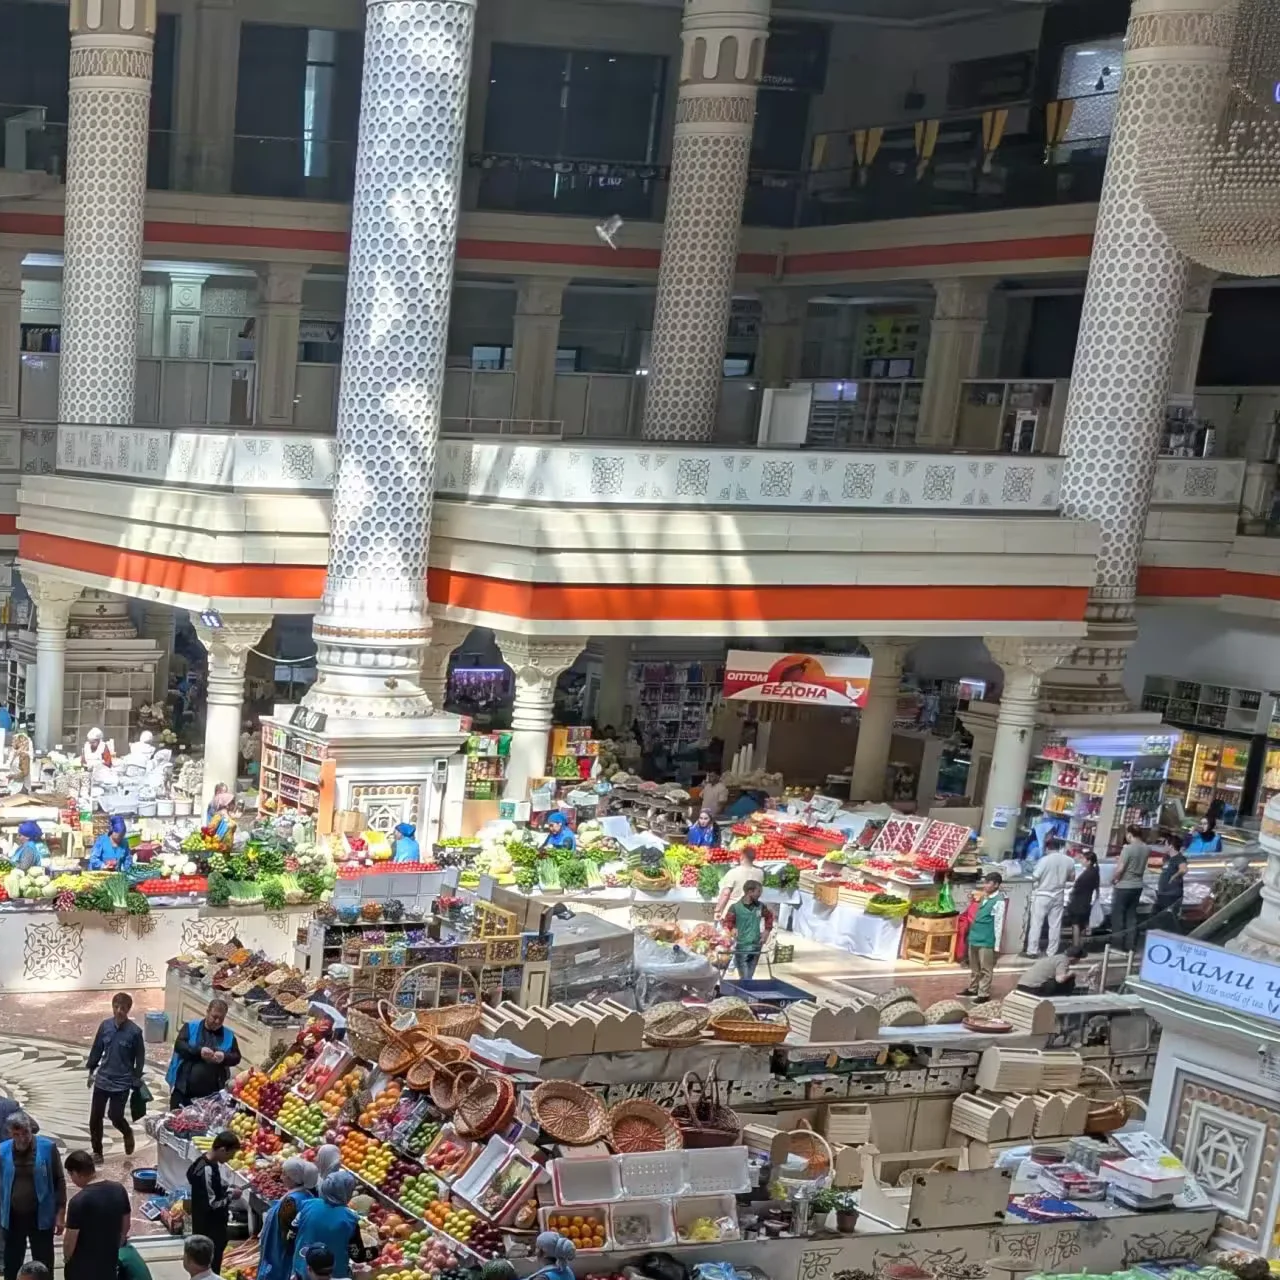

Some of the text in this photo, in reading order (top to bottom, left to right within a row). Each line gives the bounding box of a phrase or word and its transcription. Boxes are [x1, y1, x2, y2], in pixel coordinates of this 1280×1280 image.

[727, 672, 768, 683] ОПТОМ
[760, 684, 828, 698] БЕДОНА
[1147, 944, 1256, 990] Олами
